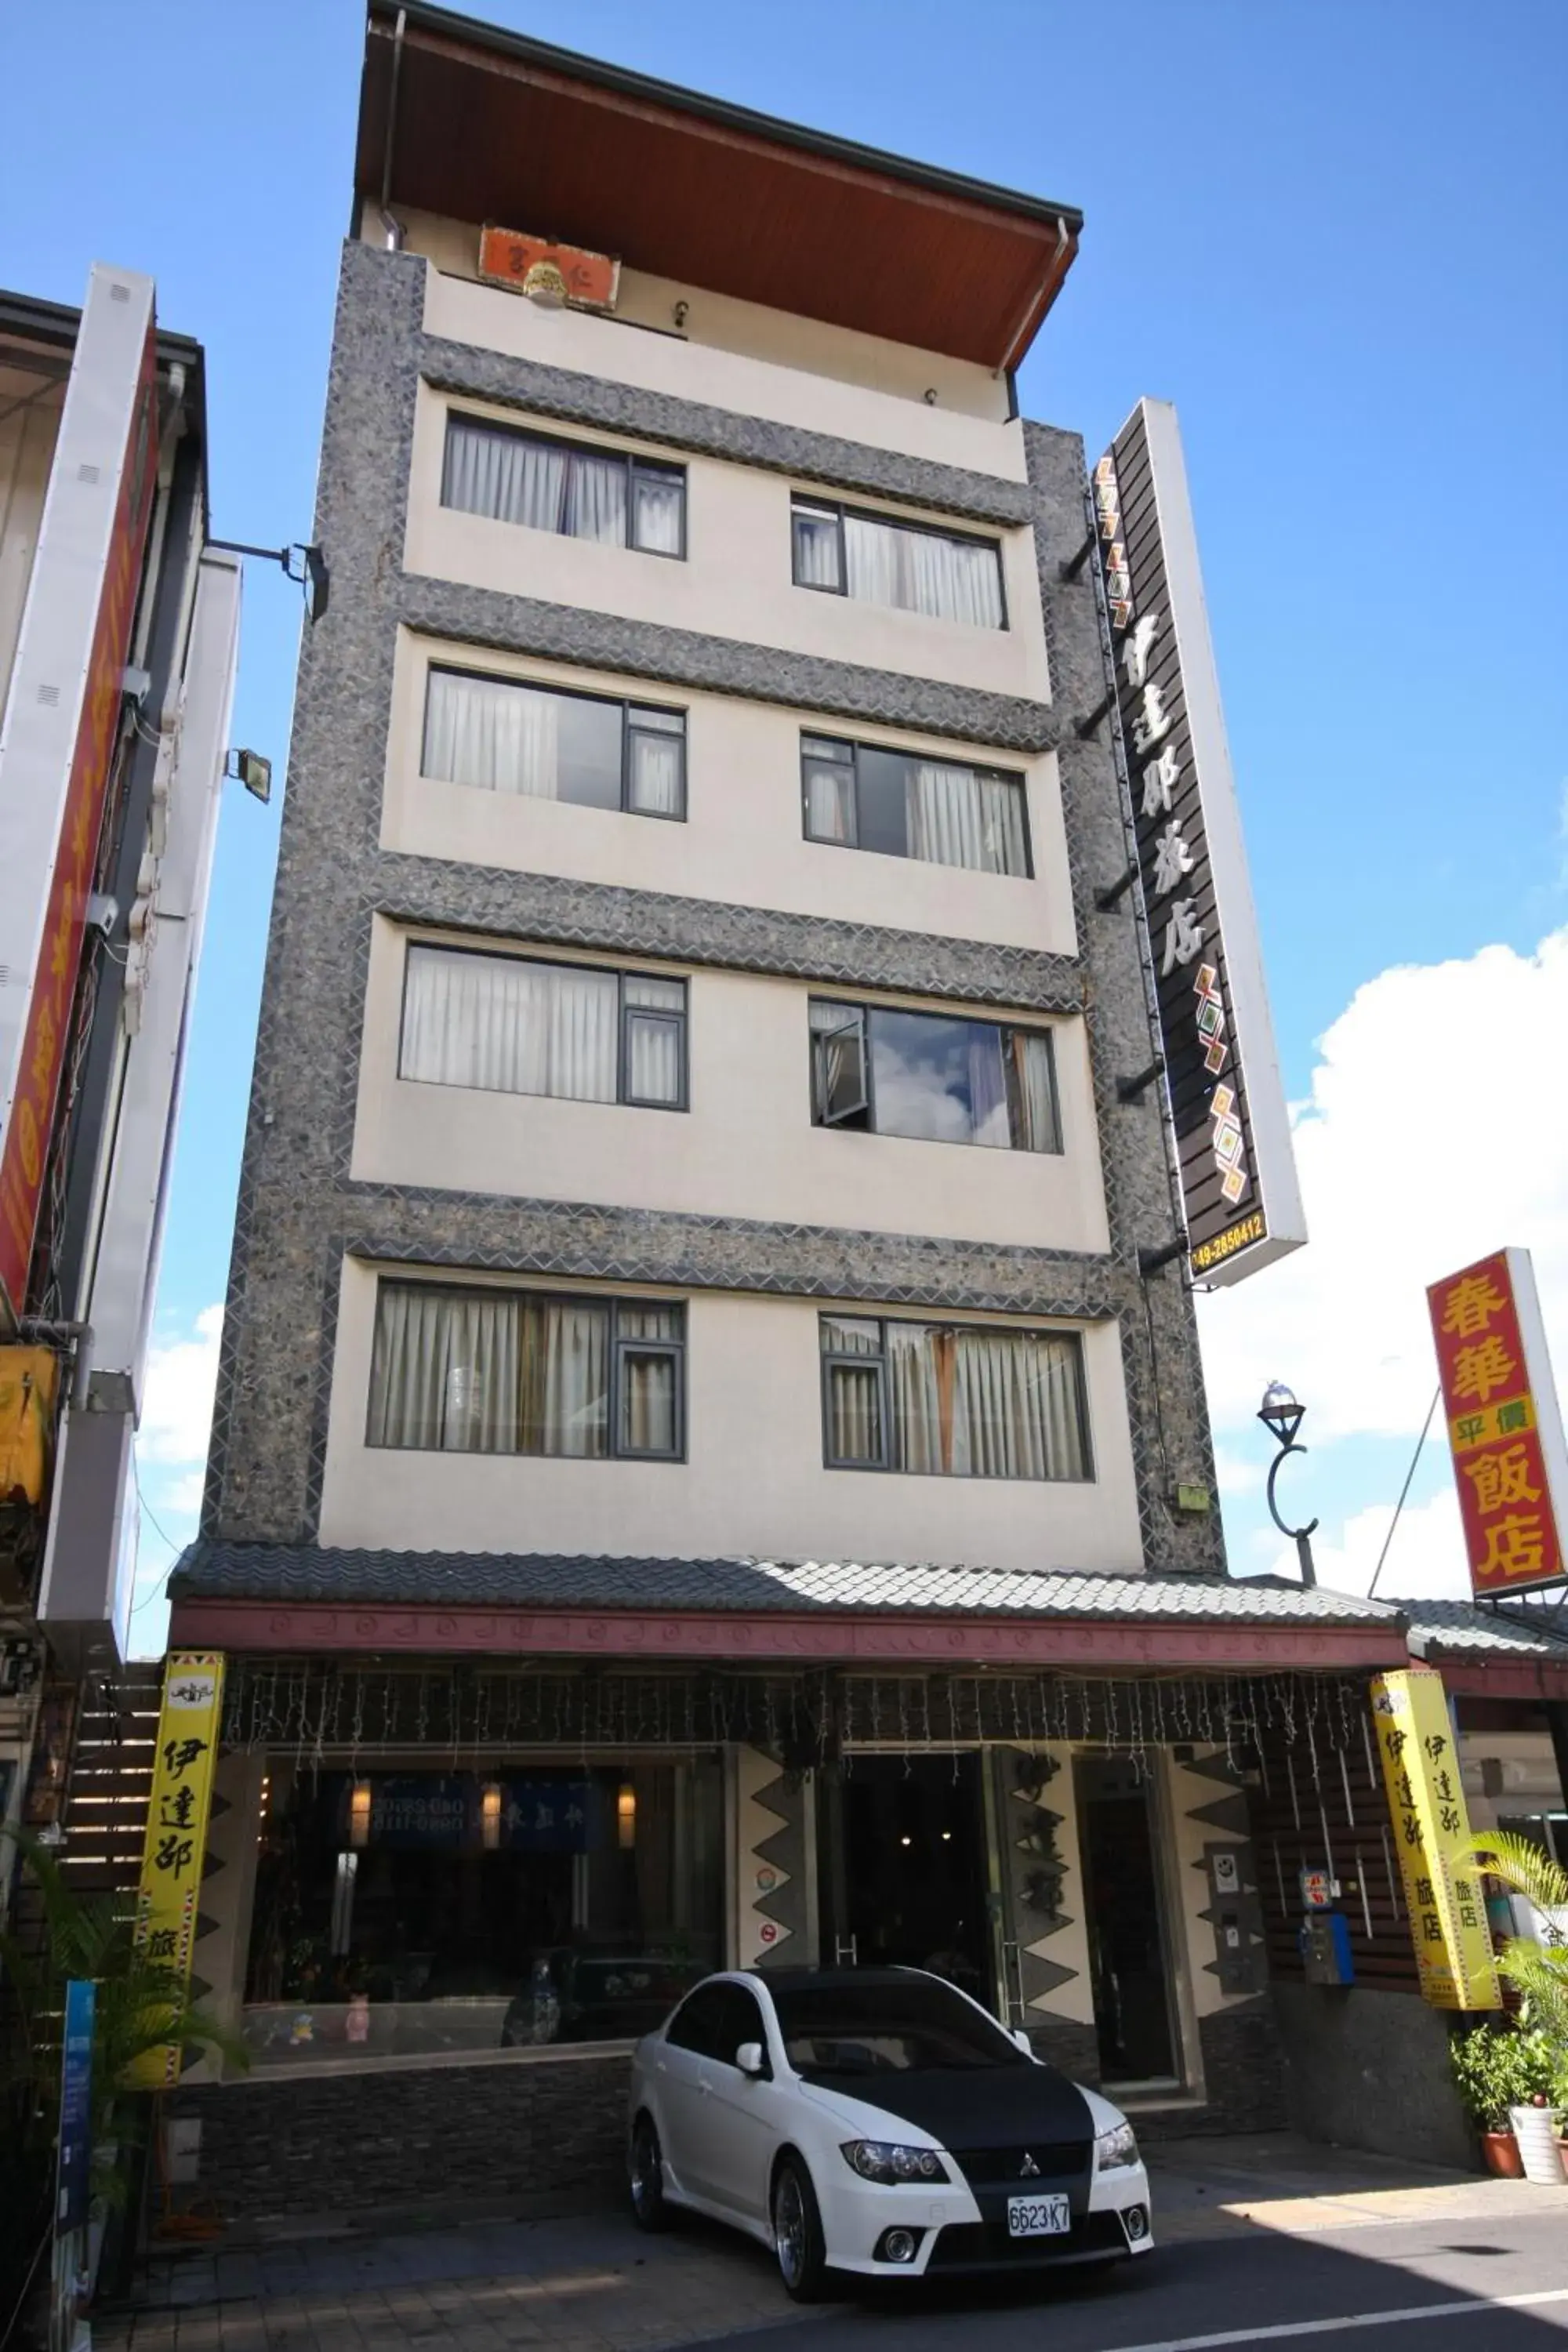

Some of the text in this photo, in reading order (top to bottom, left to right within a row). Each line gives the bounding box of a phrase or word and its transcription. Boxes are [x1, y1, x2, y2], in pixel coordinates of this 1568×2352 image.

[1441, 1272, 1516, 1403] 春華
[1457, 1398, 1530, 1445] 平價
[1463, 1442, 1542, 1577] 飯店
[154, 1737, 208, 1880] 伊達邵
[1385, 1730, 1424, 1855] 伊達邵
[1425, 1734, 1460, 1838] 伊達邵
